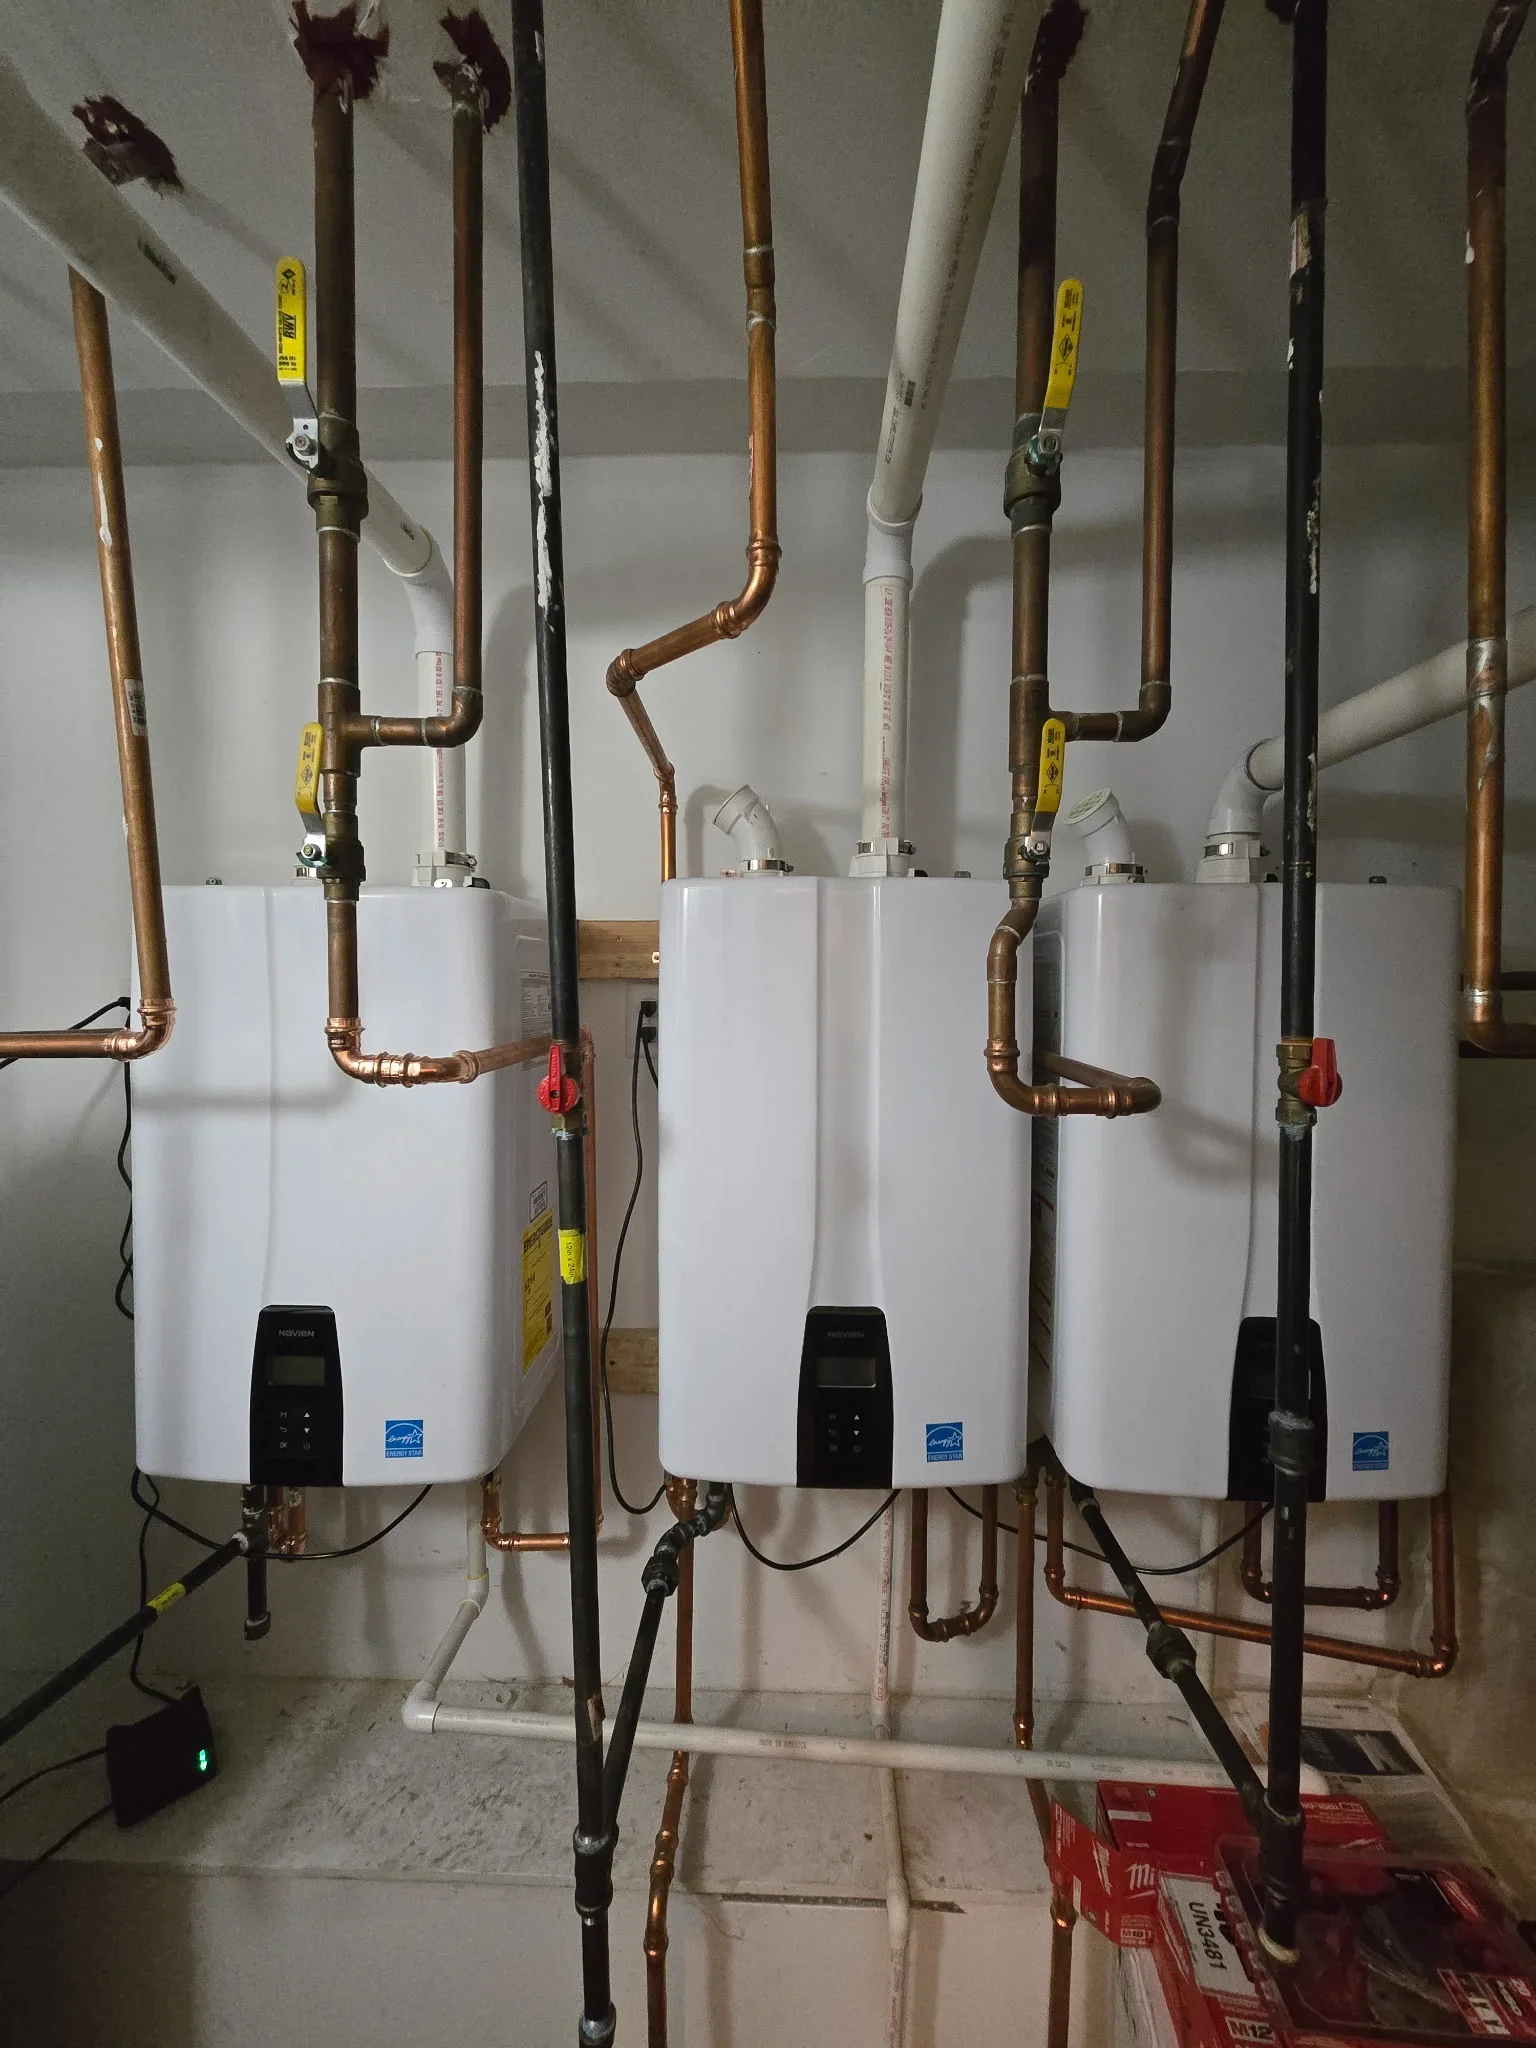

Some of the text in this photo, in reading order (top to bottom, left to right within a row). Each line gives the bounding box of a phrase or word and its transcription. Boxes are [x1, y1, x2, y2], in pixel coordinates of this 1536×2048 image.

[283, 312, 296, 339] RWV
[408, 1449, 422, 1457] STAR
[927, 1453, 962, 1462] ENERGY STAR
[1188, 1902, 1228, 1972] UN3481
[1229, 2020, 1274, 2041] M12
